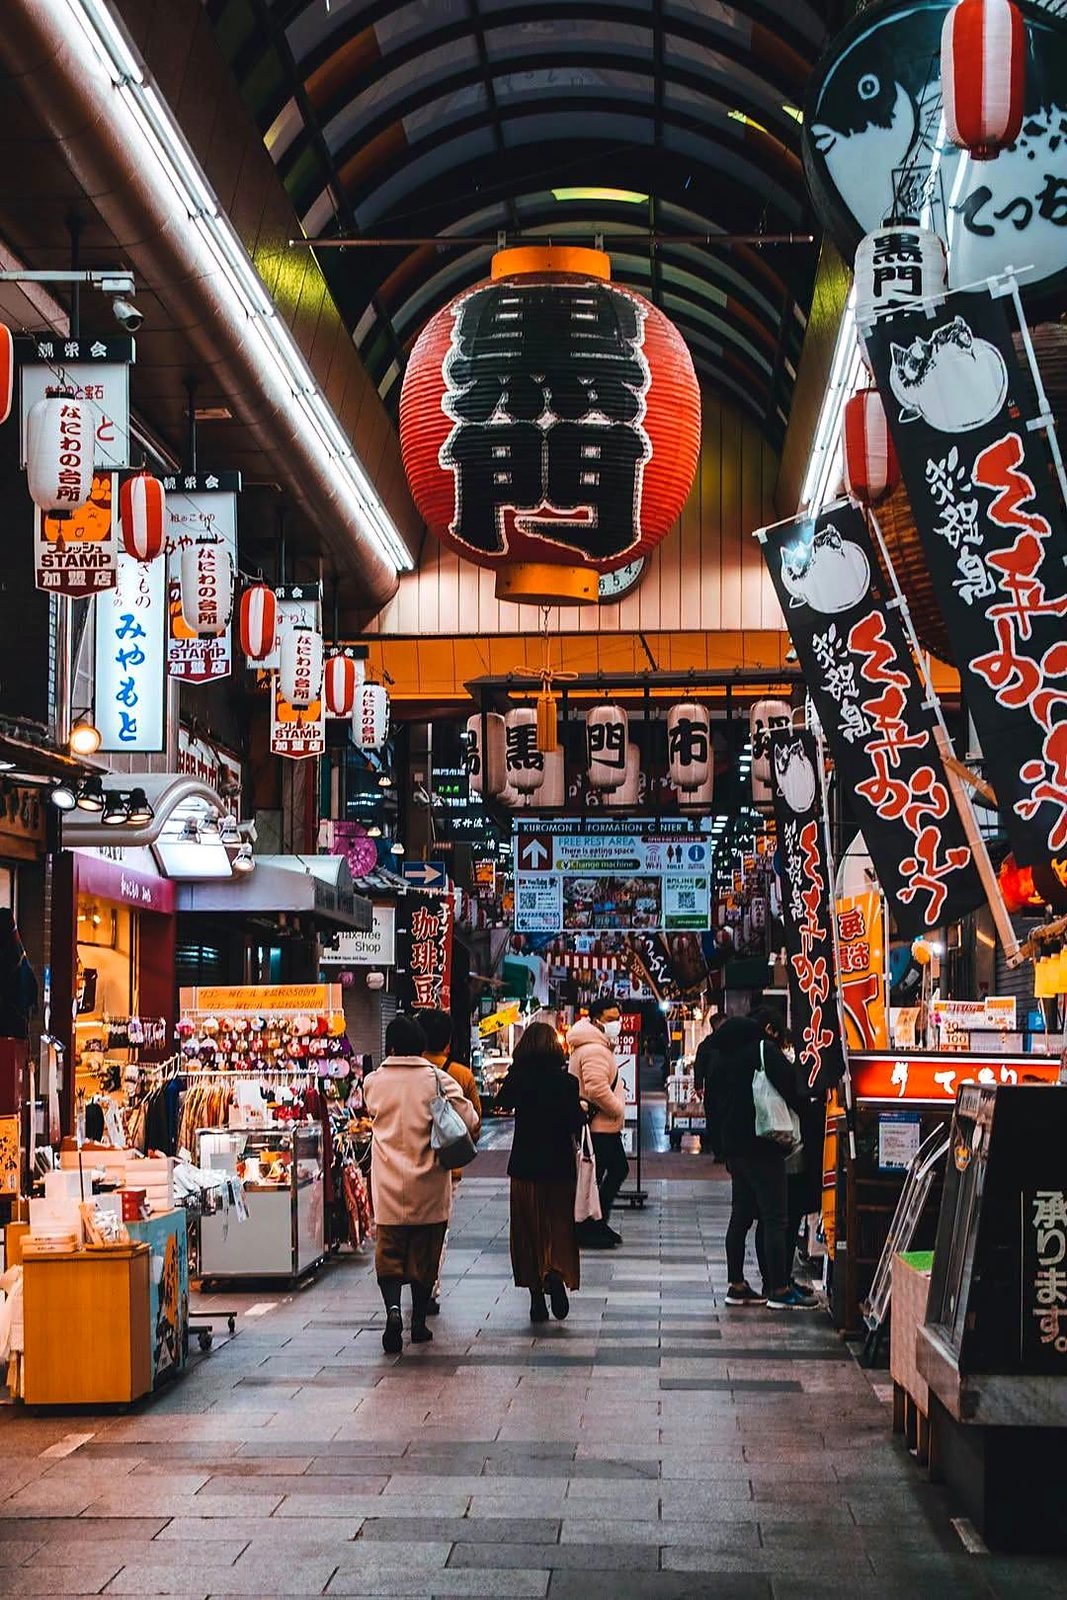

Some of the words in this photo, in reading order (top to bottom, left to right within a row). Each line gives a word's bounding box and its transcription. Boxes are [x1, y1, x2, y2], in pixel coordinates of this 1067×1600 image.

[439, 282, 653, 561] 黒門
[41, 554, 111, 568] STAMP
[41, 571, 112, 587] 加盟店
[169, 648, 226, 659] STAMP
[169, 661, 228, 674] 加盟店
[115, 613, 147, 742] みやもと
[275, 730, 321, 739] STAMP
[523, 823, 572, 832] KUROMON
[577, 823, 643, 832] IFORMATION
[647, 823, 682, 832] CNTER
[558, 837, 580, 847] FREE
[584, 837, 605, 847] REST
[610, 837, 636, 847] AREA
[561, 847, 580, 855] There
[590, 848, 613, 856] eating
[614, 848, 635, 856] space
[571, 860, 602, 870] Change
[602, 860, 634, 869] machine
[355, 941, 381, 954] Shop
[410, 906, 440, 1009] 珈琲豆
[1032, 1190, 1067, 1354] 承ります。
